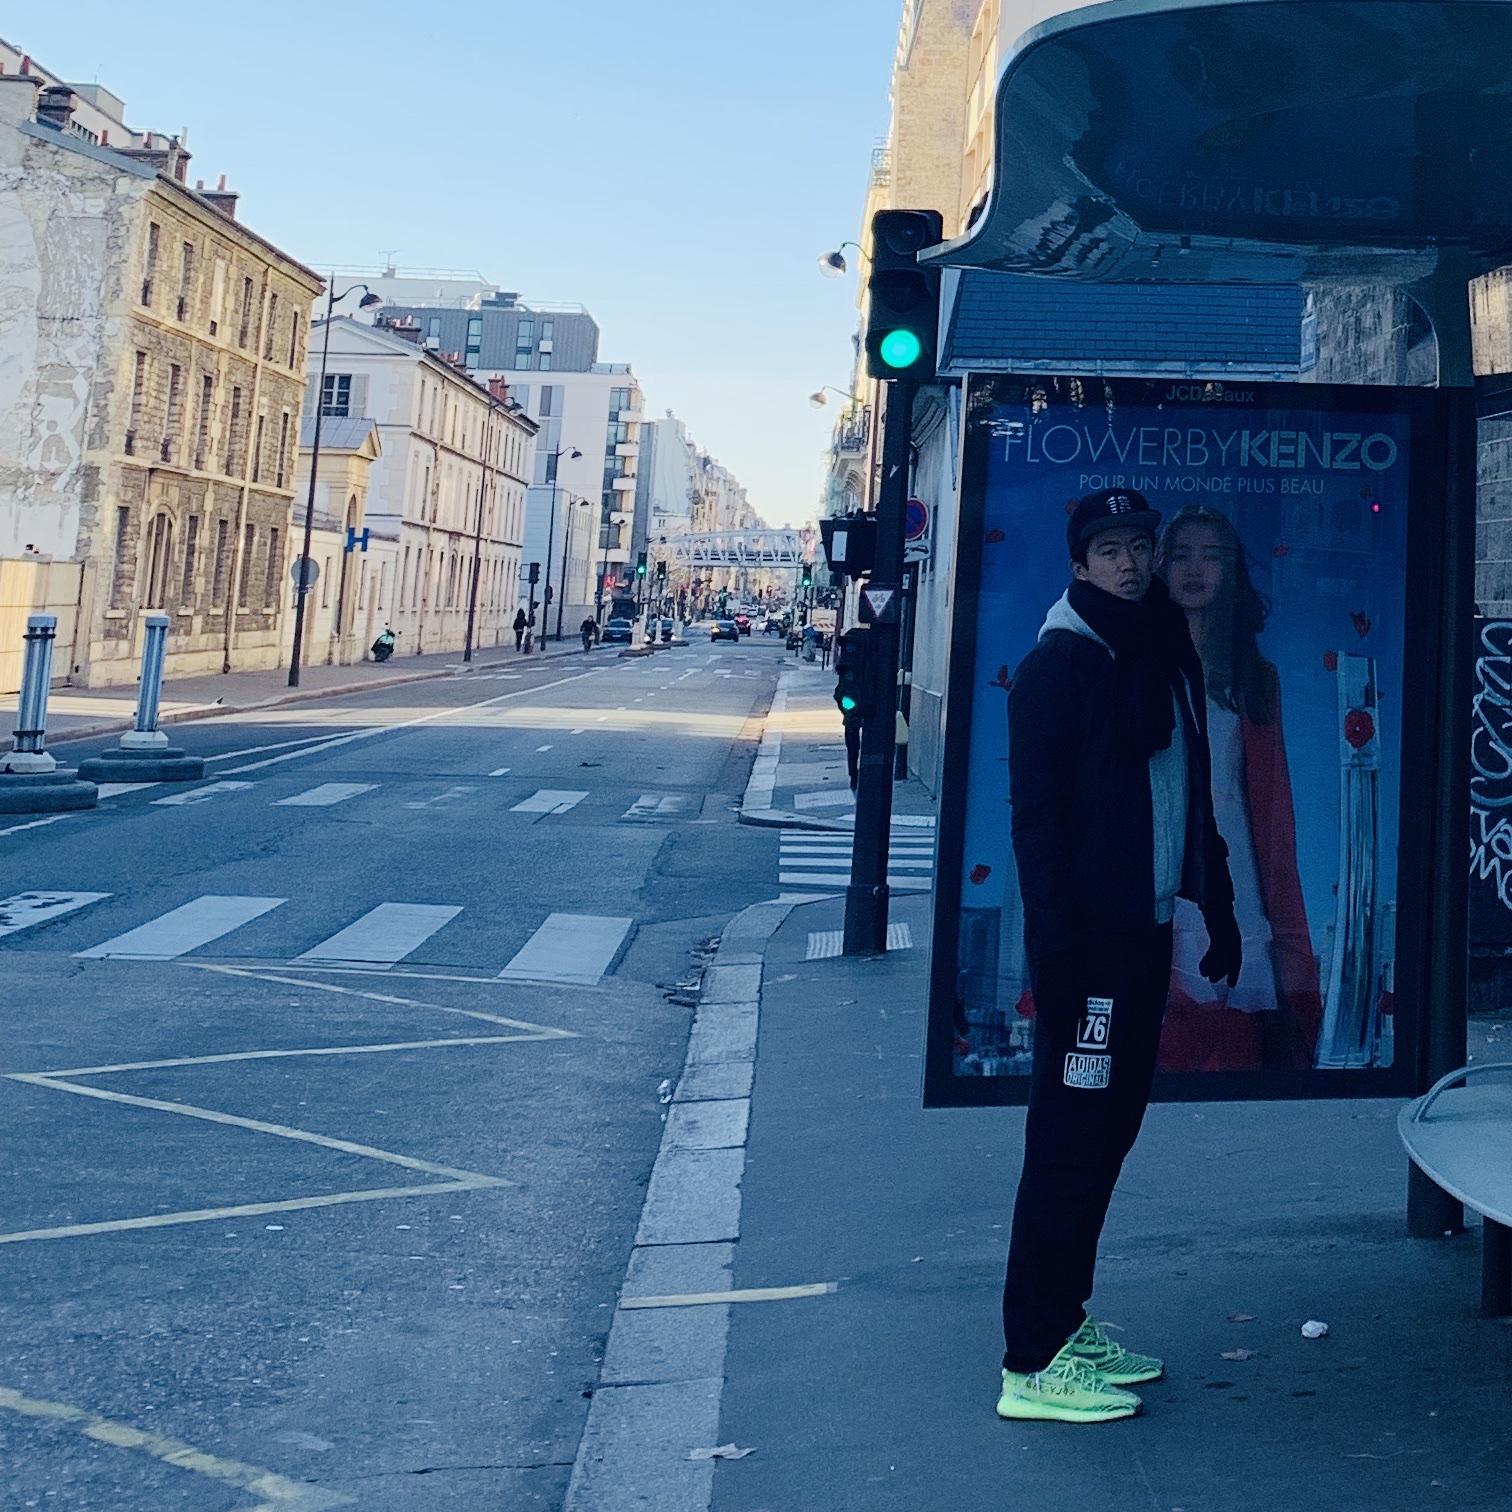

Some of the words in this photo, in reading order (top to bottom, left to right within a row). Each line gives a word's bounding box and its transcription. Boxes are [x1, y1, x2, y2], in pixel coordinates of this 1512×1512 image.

[1079, 474, 1126, 490] POUR
[1132, 475, 1159, 491] UN
[1164, 476, 1232, 493] MONDE
[1237, 477, 1275, 494] PLUS
[1280, 478, 1325, 495] BEAU
[346, 527, 370, 553] H
[1082, 1015, 1107, 1042] 76
[1067, 1055, 1110, 1074] ADIDAS
